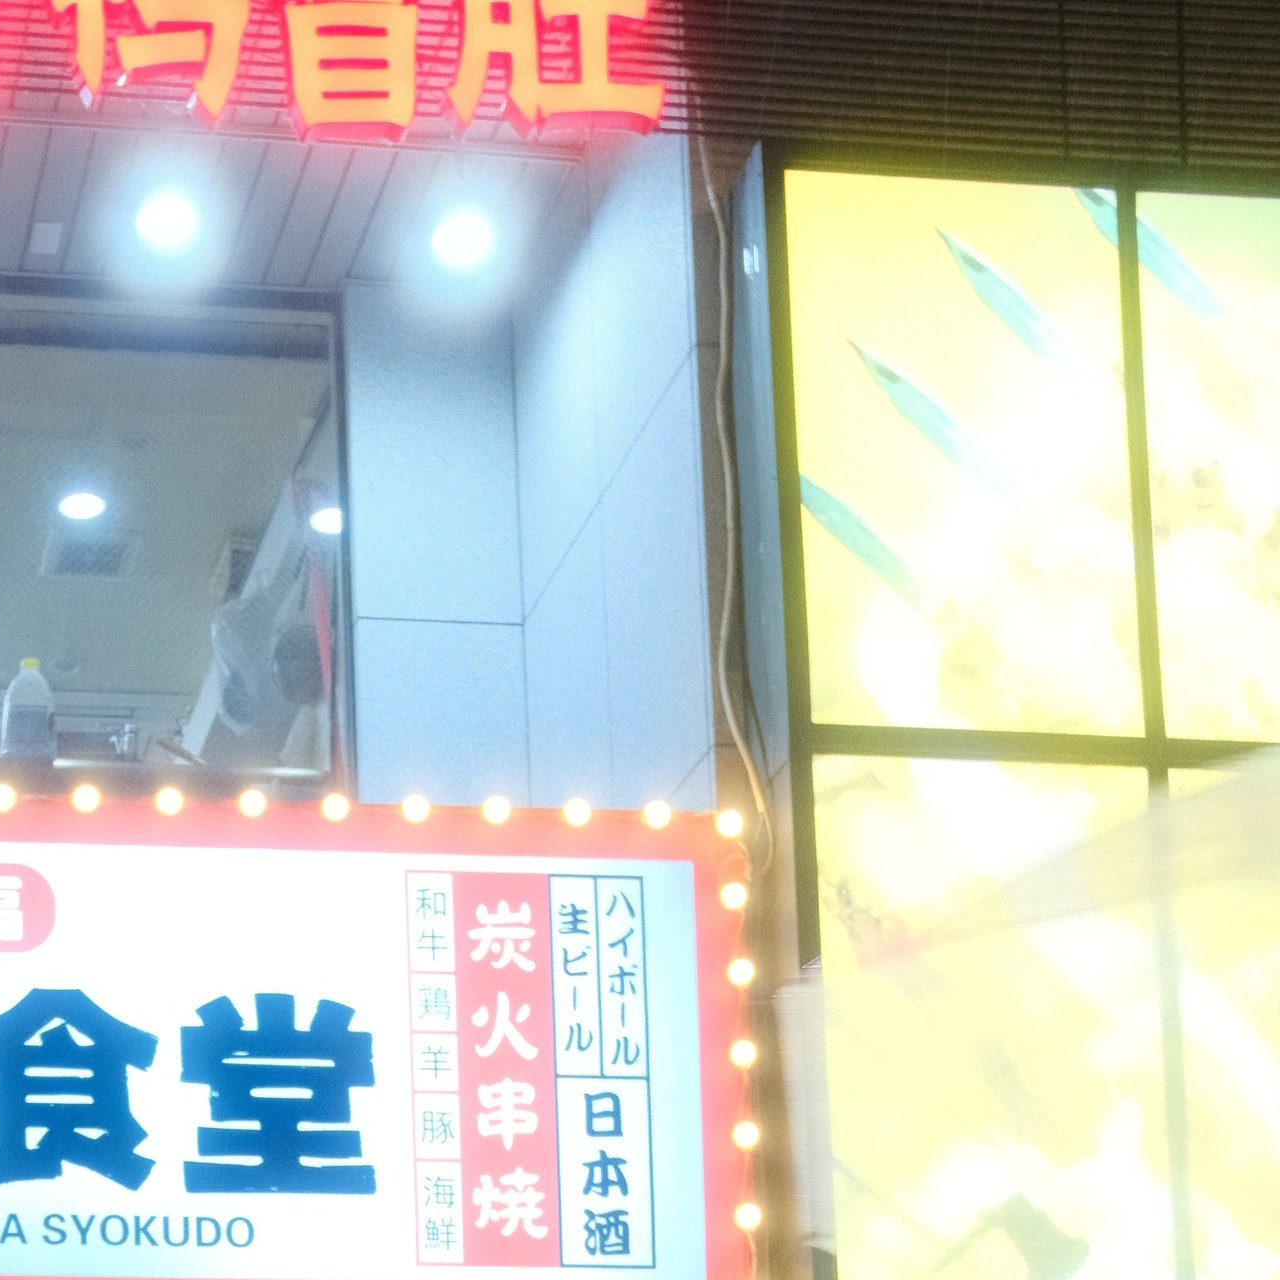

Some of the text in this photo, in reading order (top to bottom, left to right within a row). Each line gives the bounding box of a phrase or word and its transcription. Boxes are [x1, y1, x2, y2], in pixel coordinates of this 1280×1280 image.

[416, 889, 447, 961] 和牛
[418, 986, 451, 1020] 鶏
[559, 903, 593, 1054] 生ビール
[606, 892, 639, 1066] ハイボール
[421, 1046, 451, 1079] 羊
[468, 900, 548, 1239] 炭火串焼
[421, 1111, 454, 1144] 豚
[582, 1092, 632, 1256] 日本酒
[42, 1214, 255, 1248] SYOKUDO
[423, 1176, 457, 1251] 海鮮
